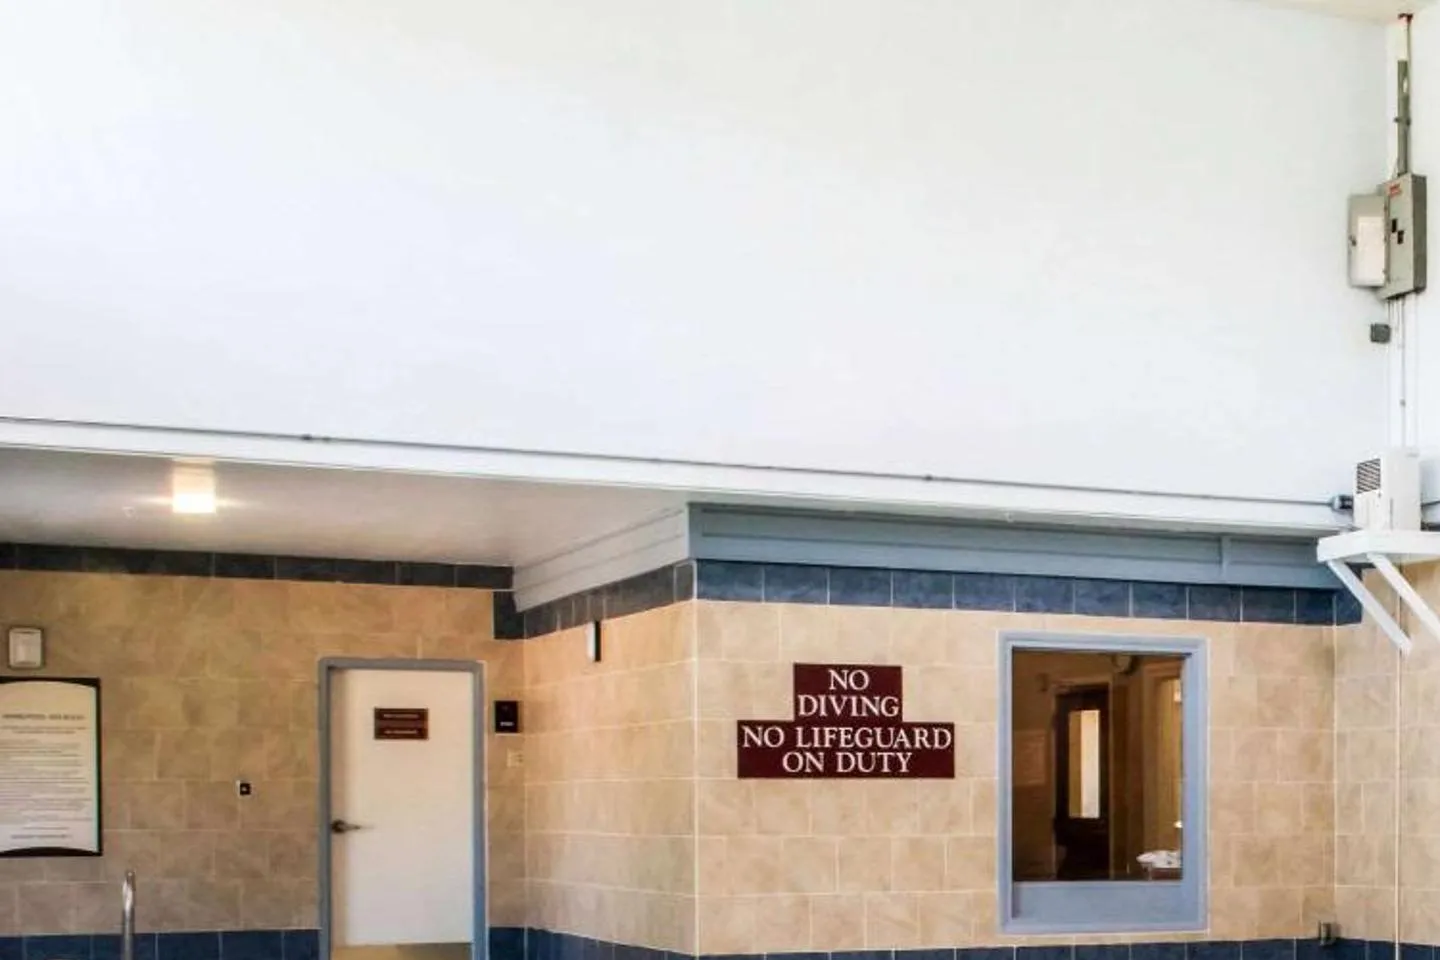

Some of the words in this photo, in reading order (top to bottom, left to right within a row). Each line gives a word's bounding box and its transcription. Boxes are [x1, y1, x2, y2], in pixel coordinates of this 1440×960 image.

[828, 669, 870, 691] NO
[798, 694, 900, 718] DIVING
[741, 725, 785, 748] NO
[795, 727, 952, 750] LIFEGUARD
[782, 752, 825, 773] ON
[836, 752, 913, 773] DUTY
